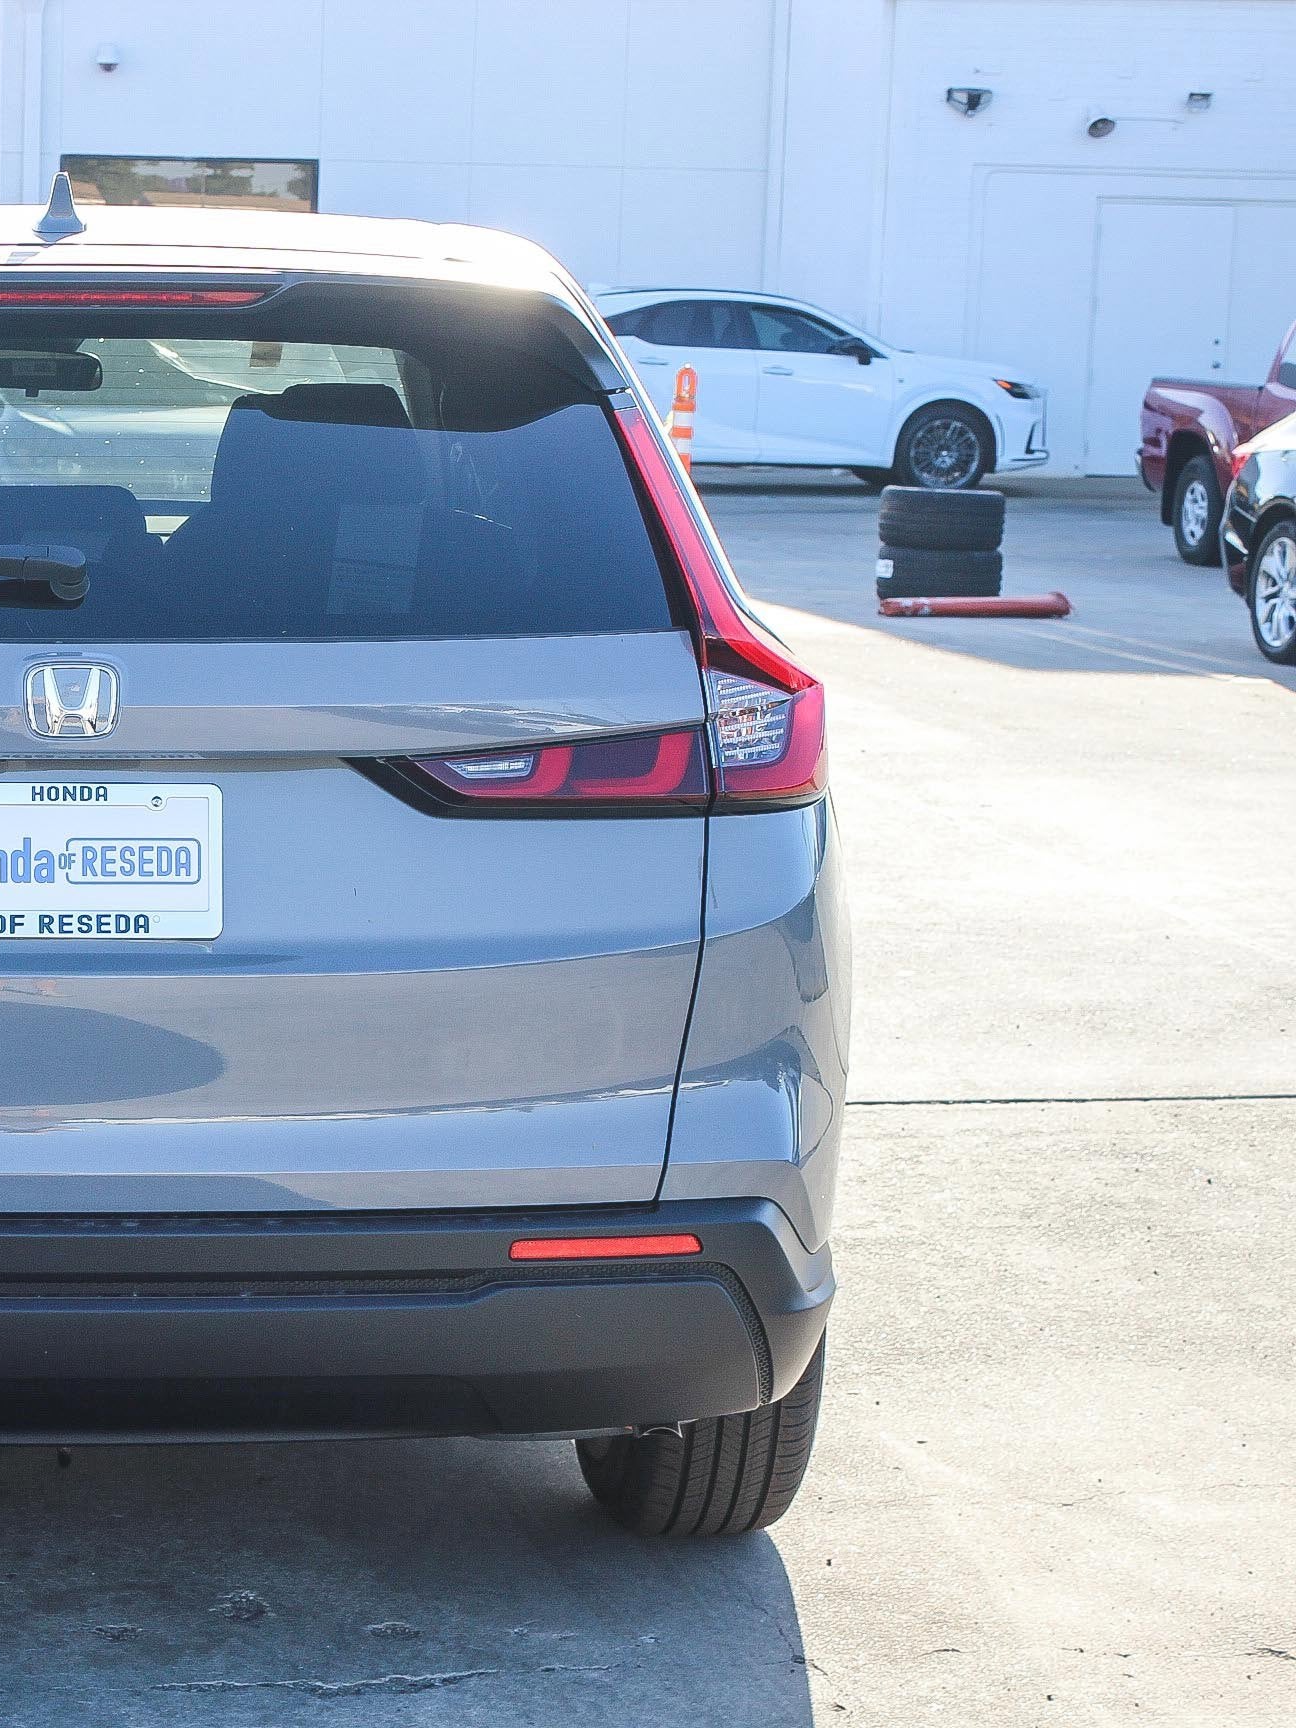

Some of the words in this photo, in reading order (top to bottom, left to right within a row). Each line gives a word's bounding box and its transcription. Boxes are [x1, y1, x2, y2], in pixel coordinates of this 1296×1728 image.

[31, 786, 108, 801] HONDA
[58, 852, 77, 870] OF
[81, 846, 191, 877] RESEDA
[39, 914, 151, 934] RESEDA
